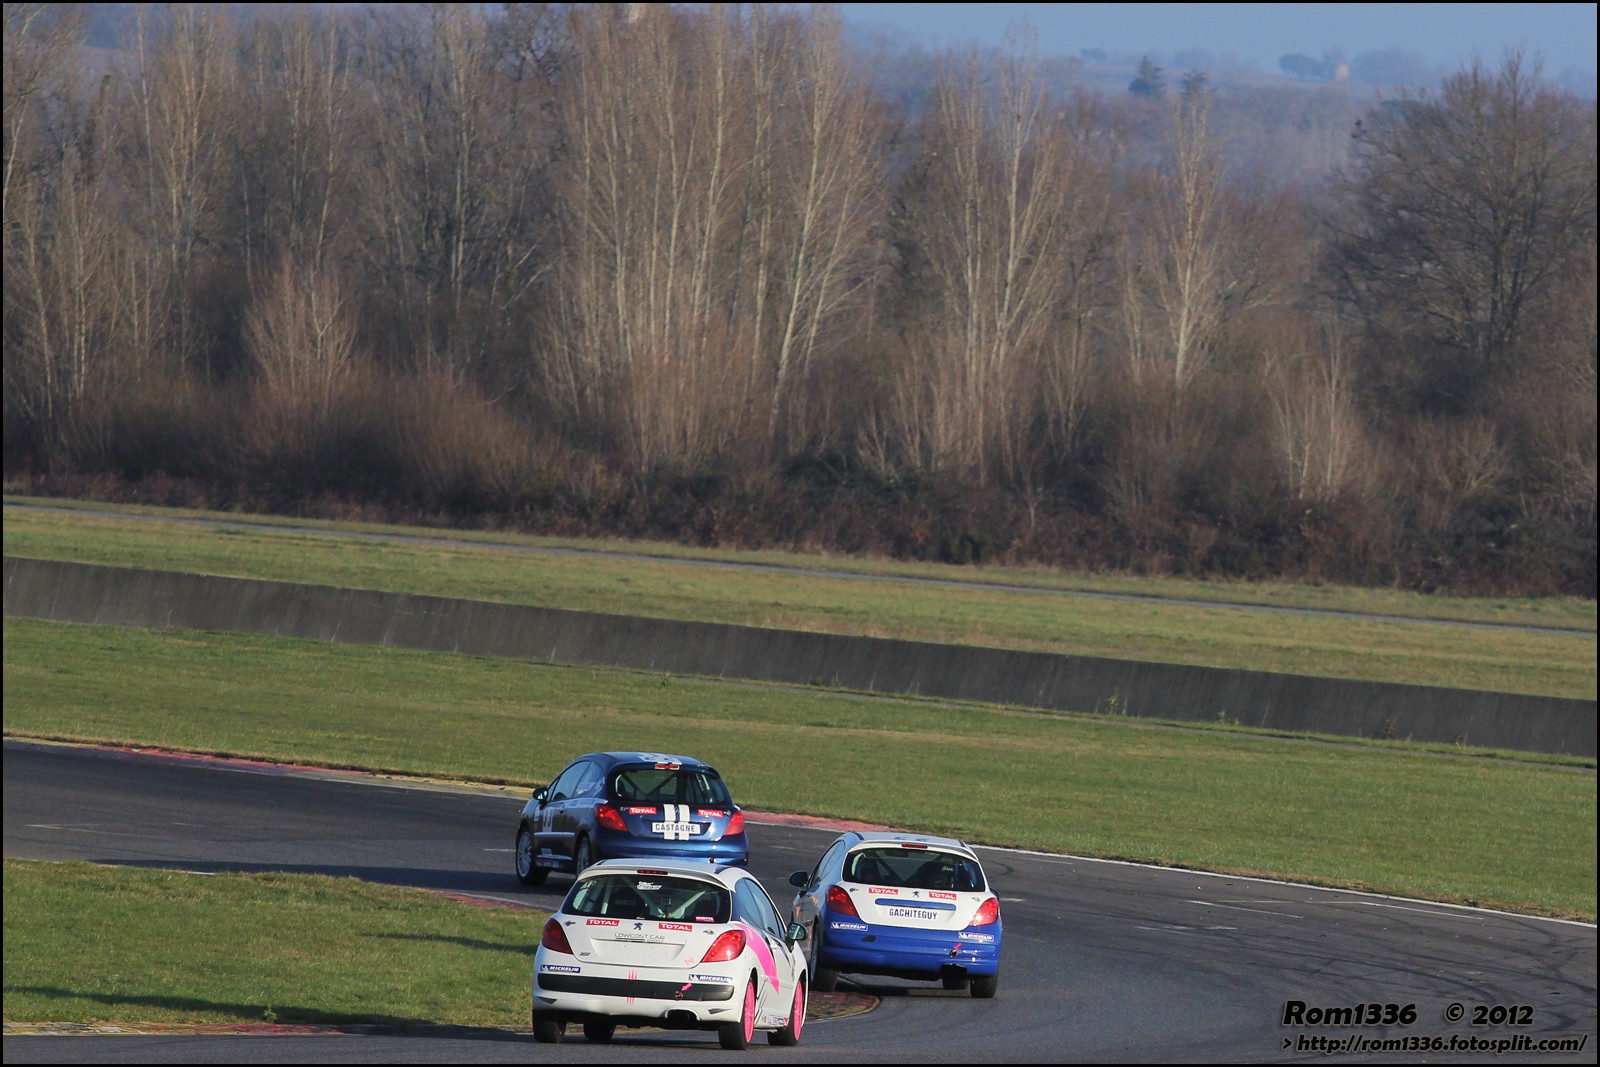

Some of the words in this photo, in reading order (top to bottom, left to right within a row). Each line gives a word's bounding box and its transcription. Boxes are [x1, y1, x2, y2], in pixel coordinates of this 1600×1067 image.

[655, 823, 696, 833] CASTAGNE
[930, 892, 957, 900] TOTAL
[889, 908, 938, 920] GACHITEGUY
[661, 923, 692, 931] TOTAL
